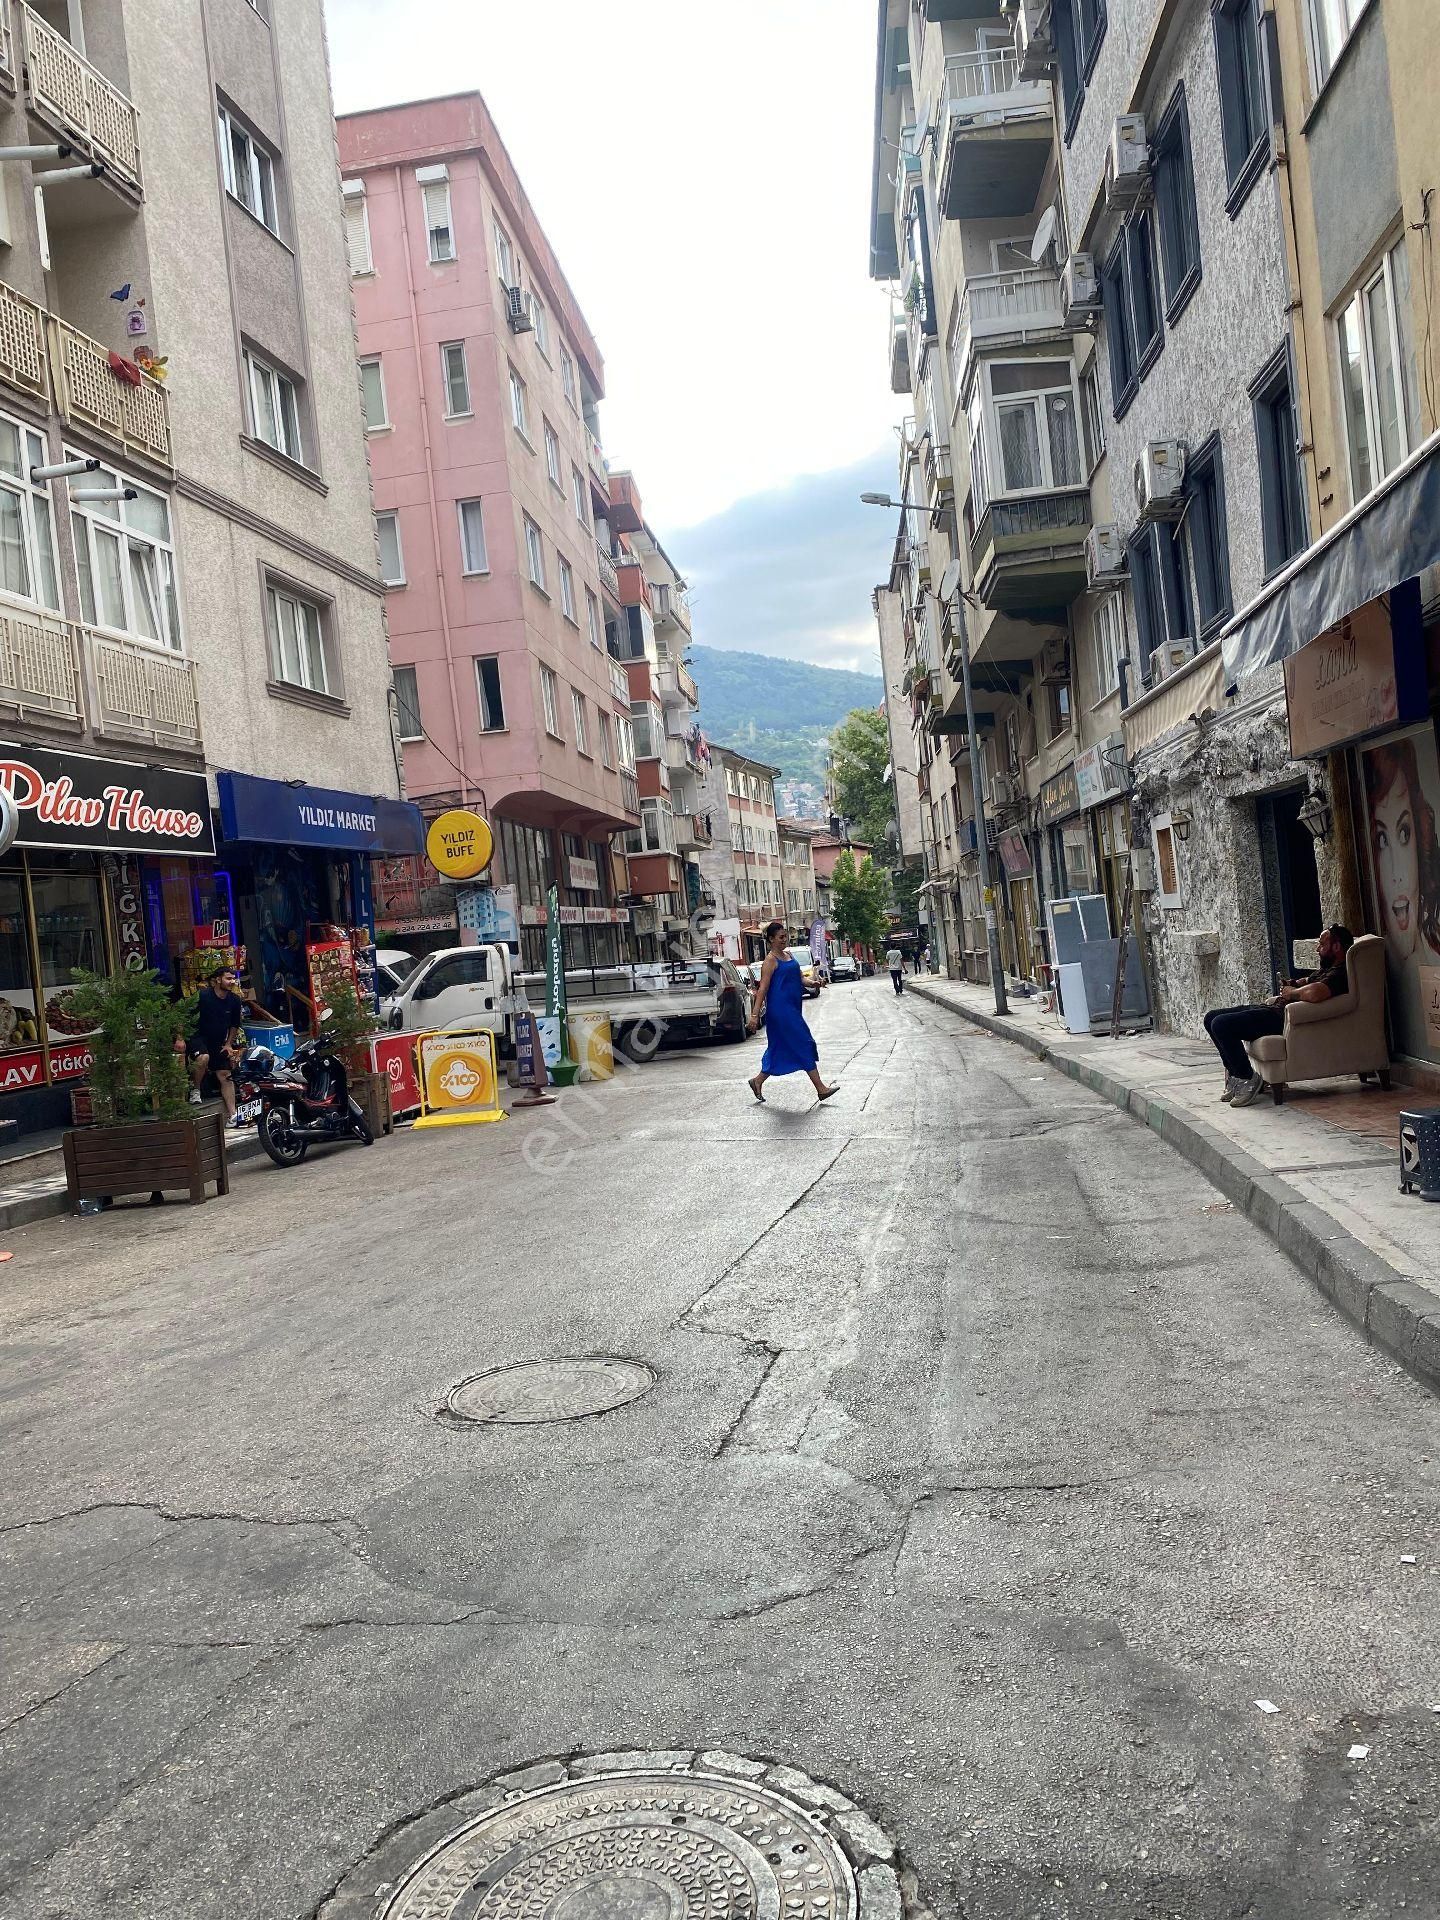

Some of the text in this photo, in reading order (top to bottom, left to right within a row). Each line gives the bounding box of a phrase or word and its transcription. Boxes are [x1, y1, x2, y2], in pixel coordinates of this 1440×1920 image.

[0, 760, 203, 838] Pilav House
[299, 806, 376, 832] YILDIZ MARKET
[441, 830, 475, 844] YILDIZ
[357, 852, 370, 927] YIL
[0, 1064, 38, 1087] AV
[50, 1050, 97, 1077] ÇİĞKÖ
[441, 1073, 478, 1089] %100
